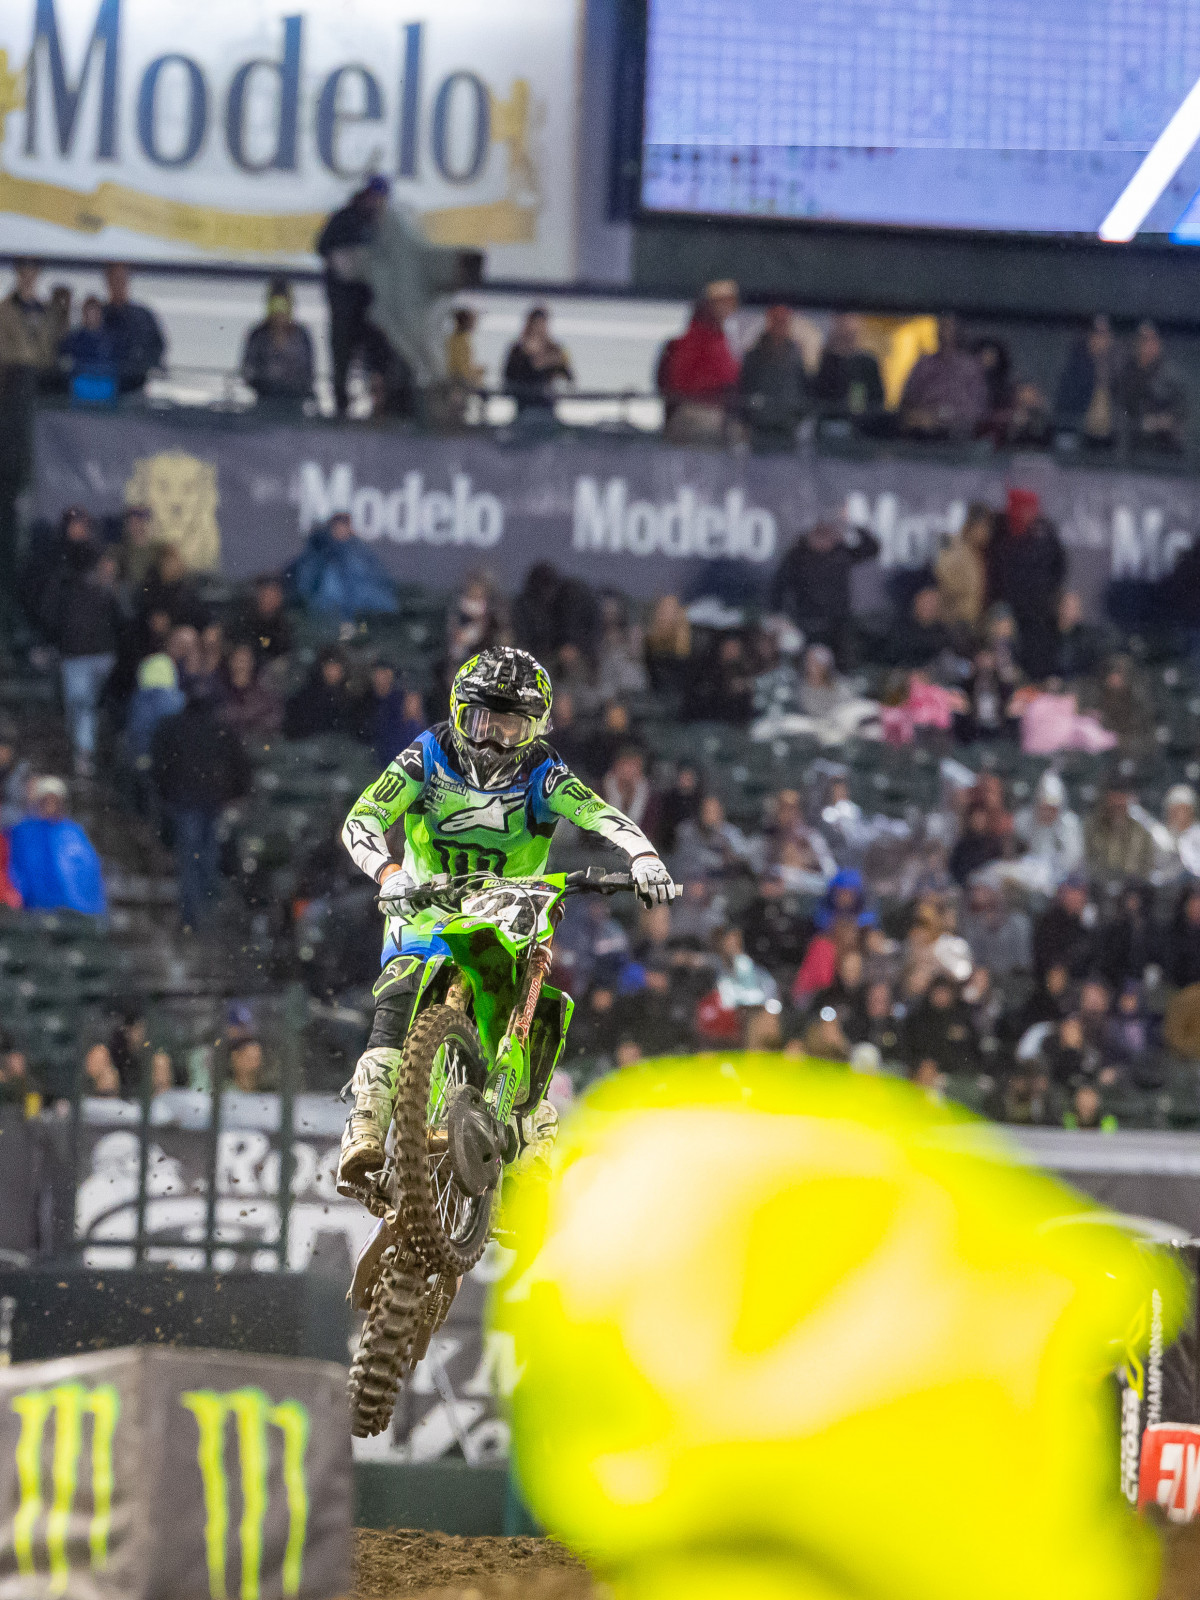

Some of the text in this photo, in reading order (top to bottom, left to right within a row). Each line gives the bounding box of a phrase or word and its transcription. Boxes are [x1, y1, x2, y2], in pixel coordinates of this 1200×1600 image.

[20, 0, 492, 185] Modelo
[299, 461, 503, 547] Modelo
[572, 474, 778, 562] Modelo
